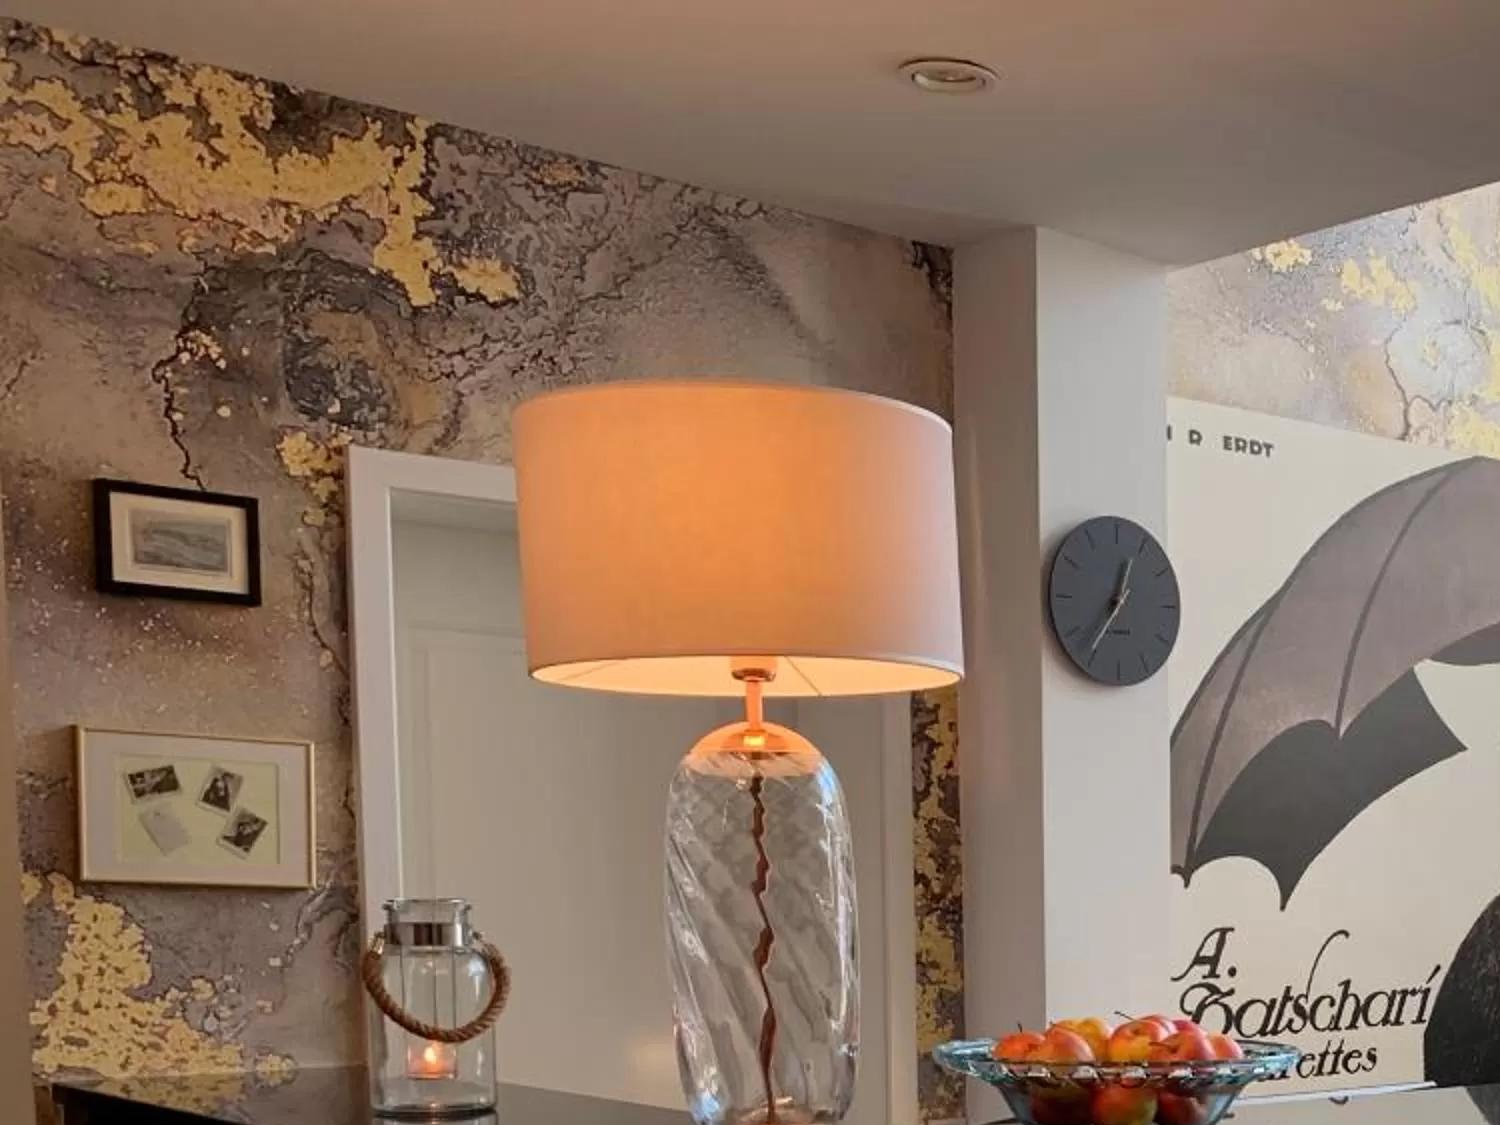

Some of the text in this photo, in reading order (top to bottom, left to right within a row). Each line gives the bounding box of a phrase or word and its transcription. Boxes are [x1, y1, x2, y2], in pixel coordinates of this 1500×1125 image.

[1222, 435, 1275, 459] ERDT
[1170, 926, 1238, 983] A.
[1257, 1039, 1378, 1082] ettes
